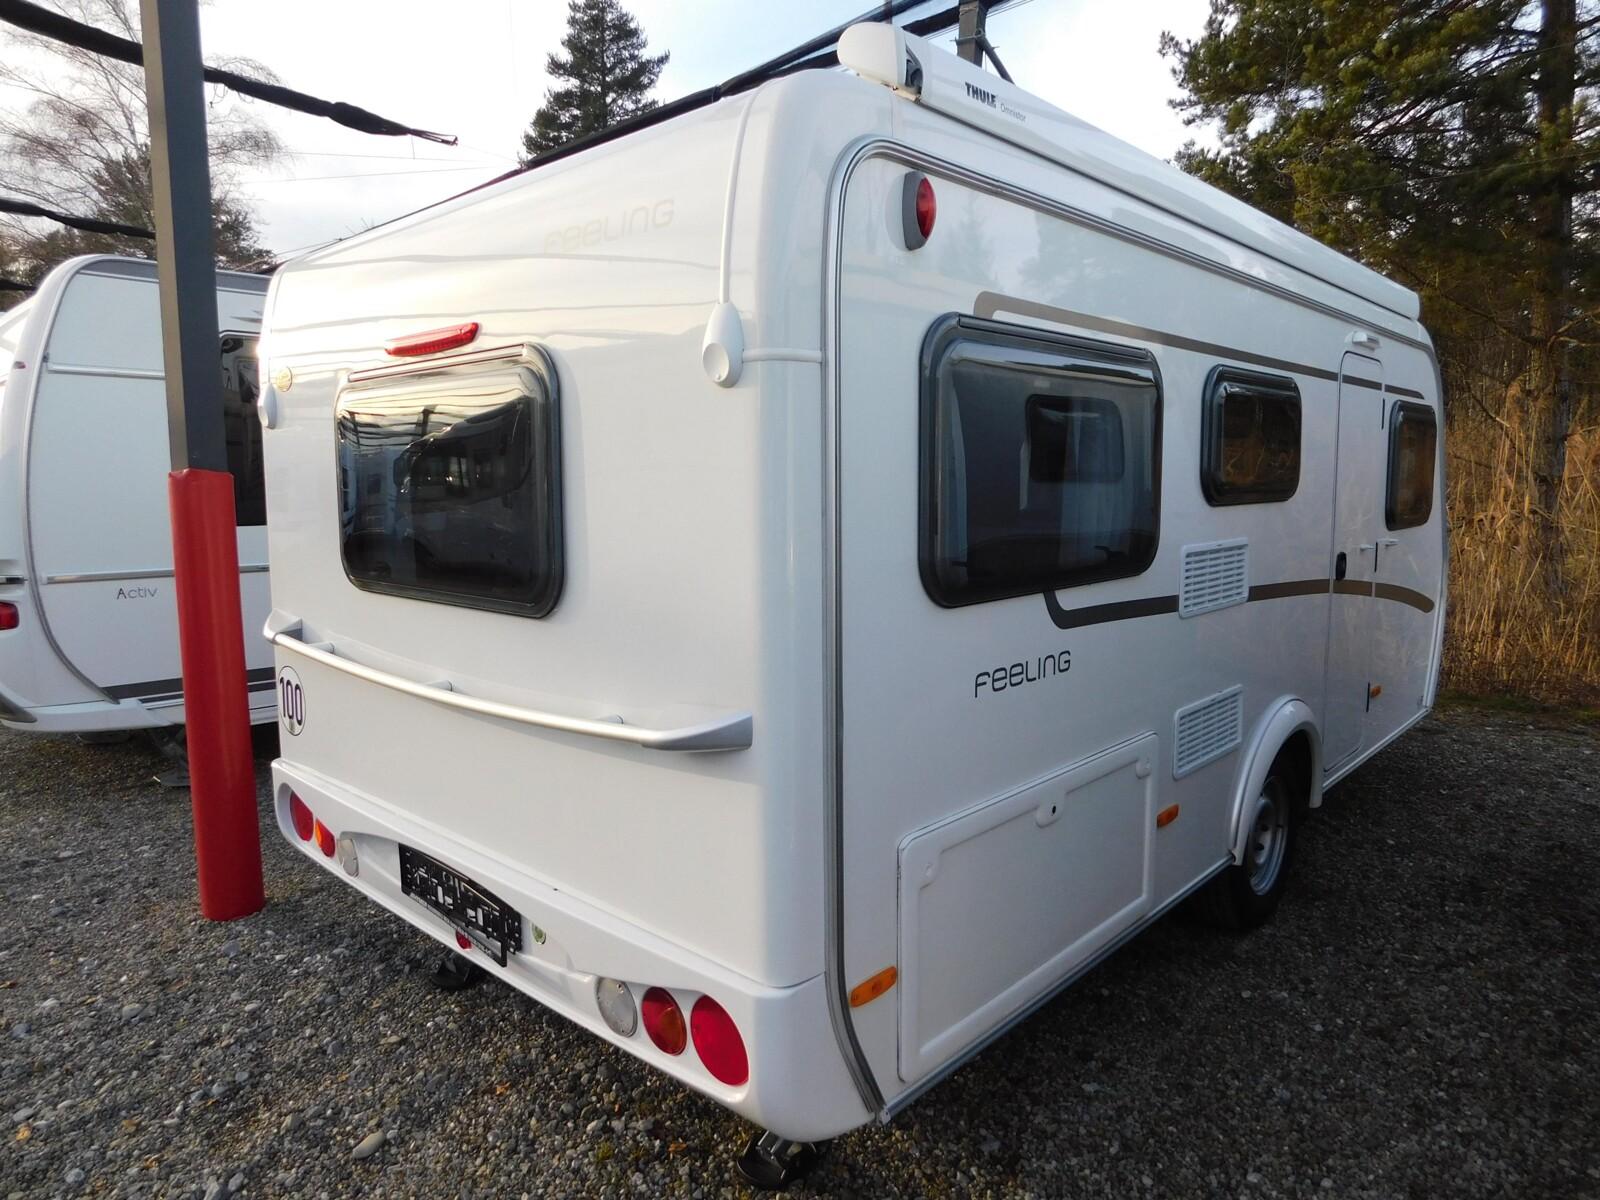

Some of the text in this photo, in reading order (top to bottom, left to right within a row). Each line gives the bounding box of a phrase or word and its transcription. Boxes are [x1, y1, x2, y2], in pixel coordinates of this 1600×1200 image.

[965, 82, 997, 107] THULE
[117, 587, 158, 600] Activ
[279, 677, 303, 726] 100
